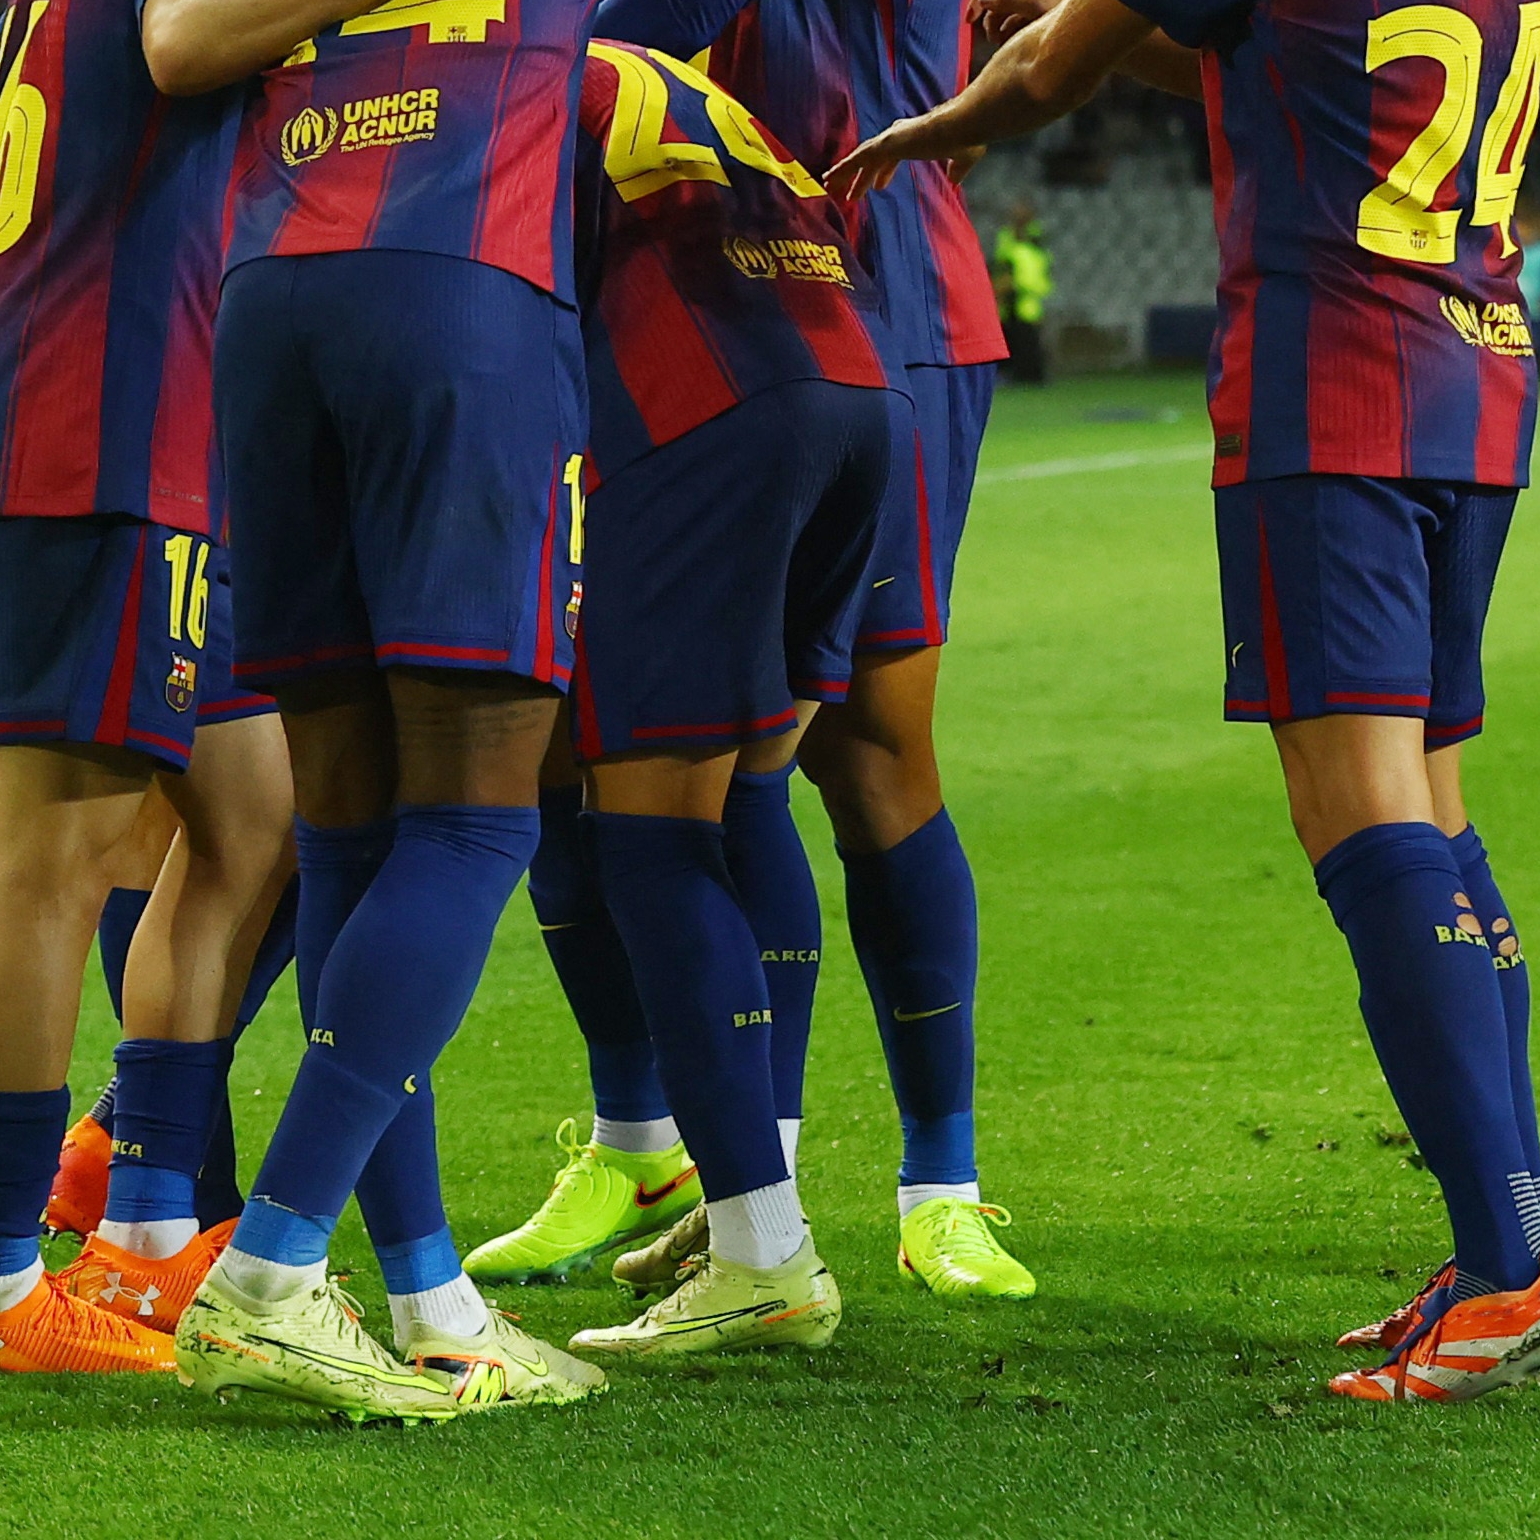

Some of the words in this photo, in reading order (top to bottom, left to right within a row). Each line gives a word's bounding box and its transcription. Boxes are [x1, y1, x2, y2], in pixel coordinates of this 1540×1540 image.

[0, 0, 50, 255] 6
[340, 109, 437, 146] ACNUR
[343, 88, 440, 123] UNHCR
[164, 534, 210, 650] 16
